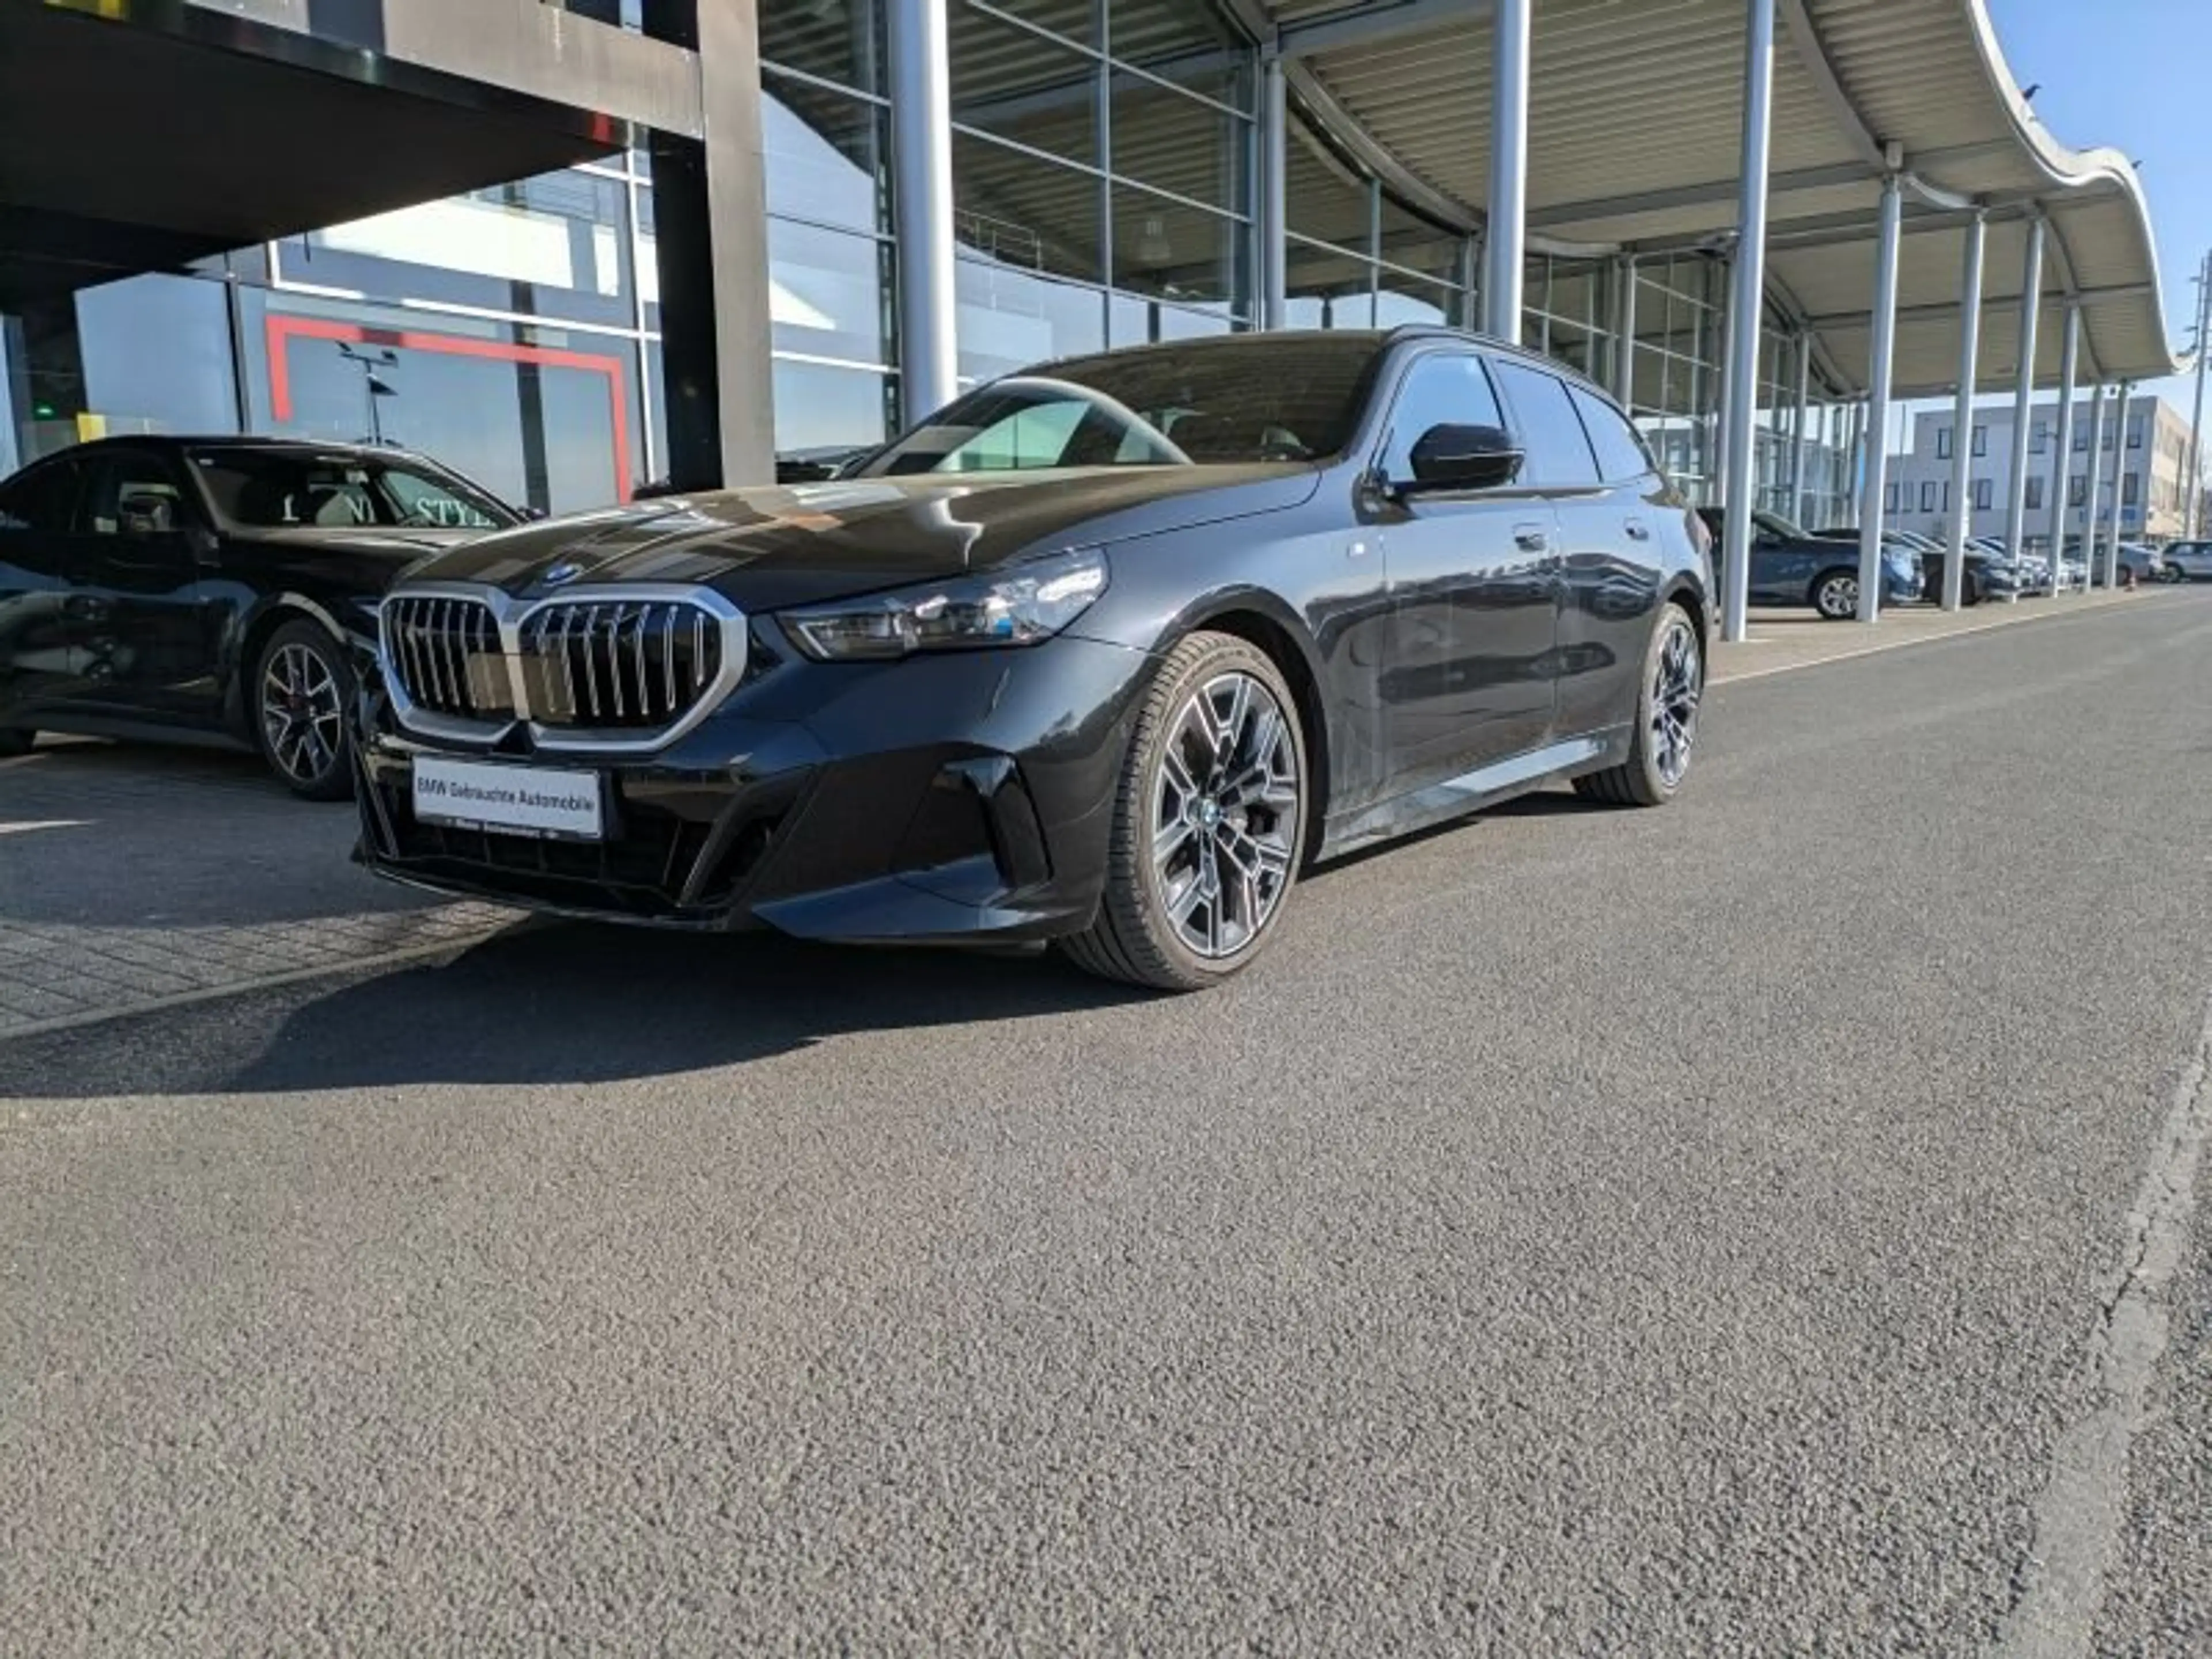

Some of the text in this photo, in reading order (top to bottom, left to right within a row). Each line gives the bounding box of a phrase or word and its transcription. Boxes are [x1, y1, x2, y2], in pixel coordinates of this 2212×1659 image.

[416, 497, 497, 527] STYL
[417, 777, 594, 811] BMW Gebrauchte Automobile
